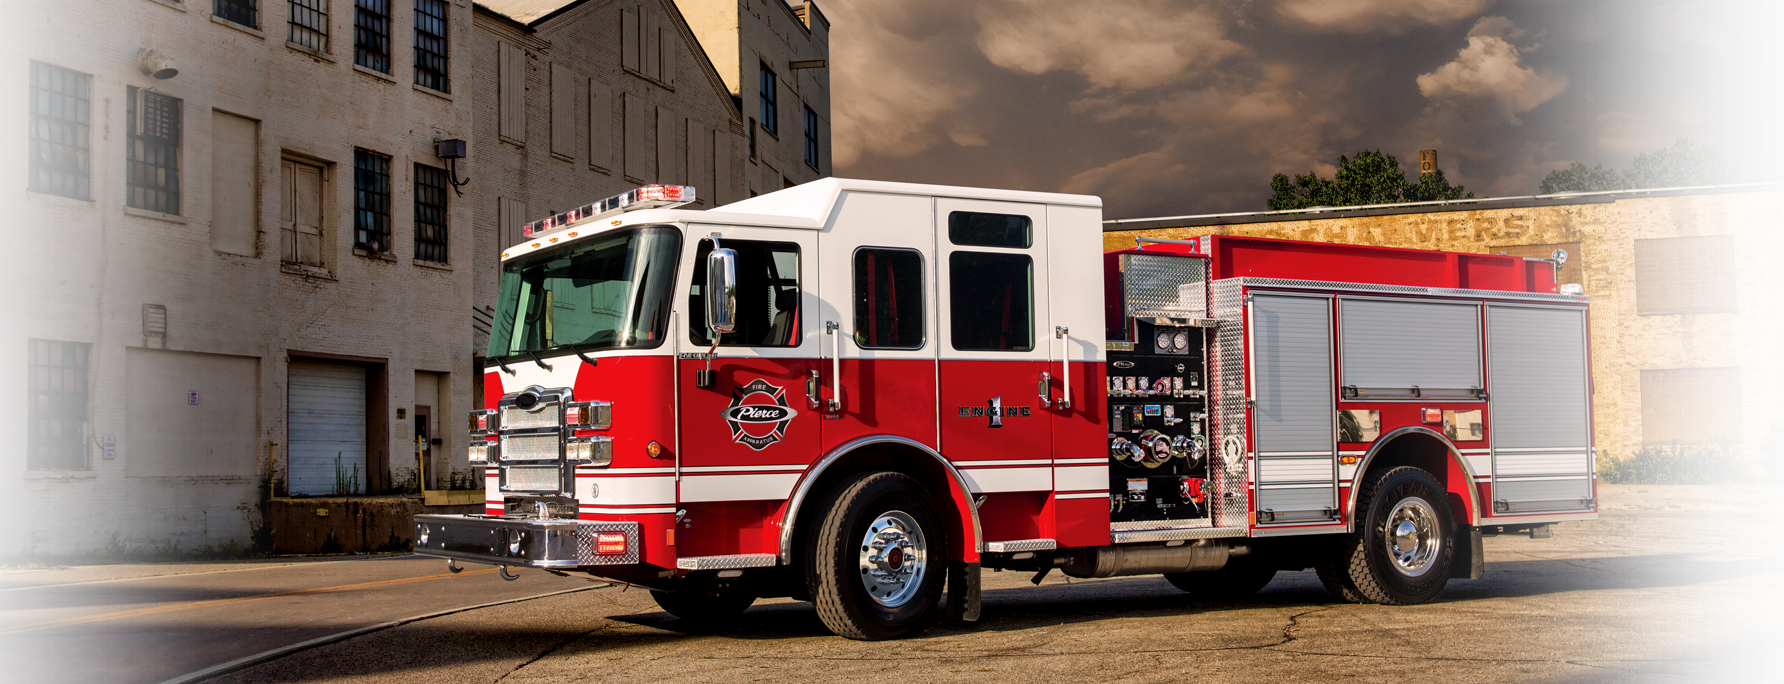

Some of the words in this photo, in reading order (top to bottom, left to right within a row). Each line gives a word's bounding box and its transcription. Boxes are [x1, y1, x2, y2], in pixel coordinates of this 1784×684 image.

[736, 406, 780, 420] Pierce
[958, 406, 1031, 418] ENGINE
[986, 395, 1004, 429] 1
[743, 436, 774, 445] APPARATUS
